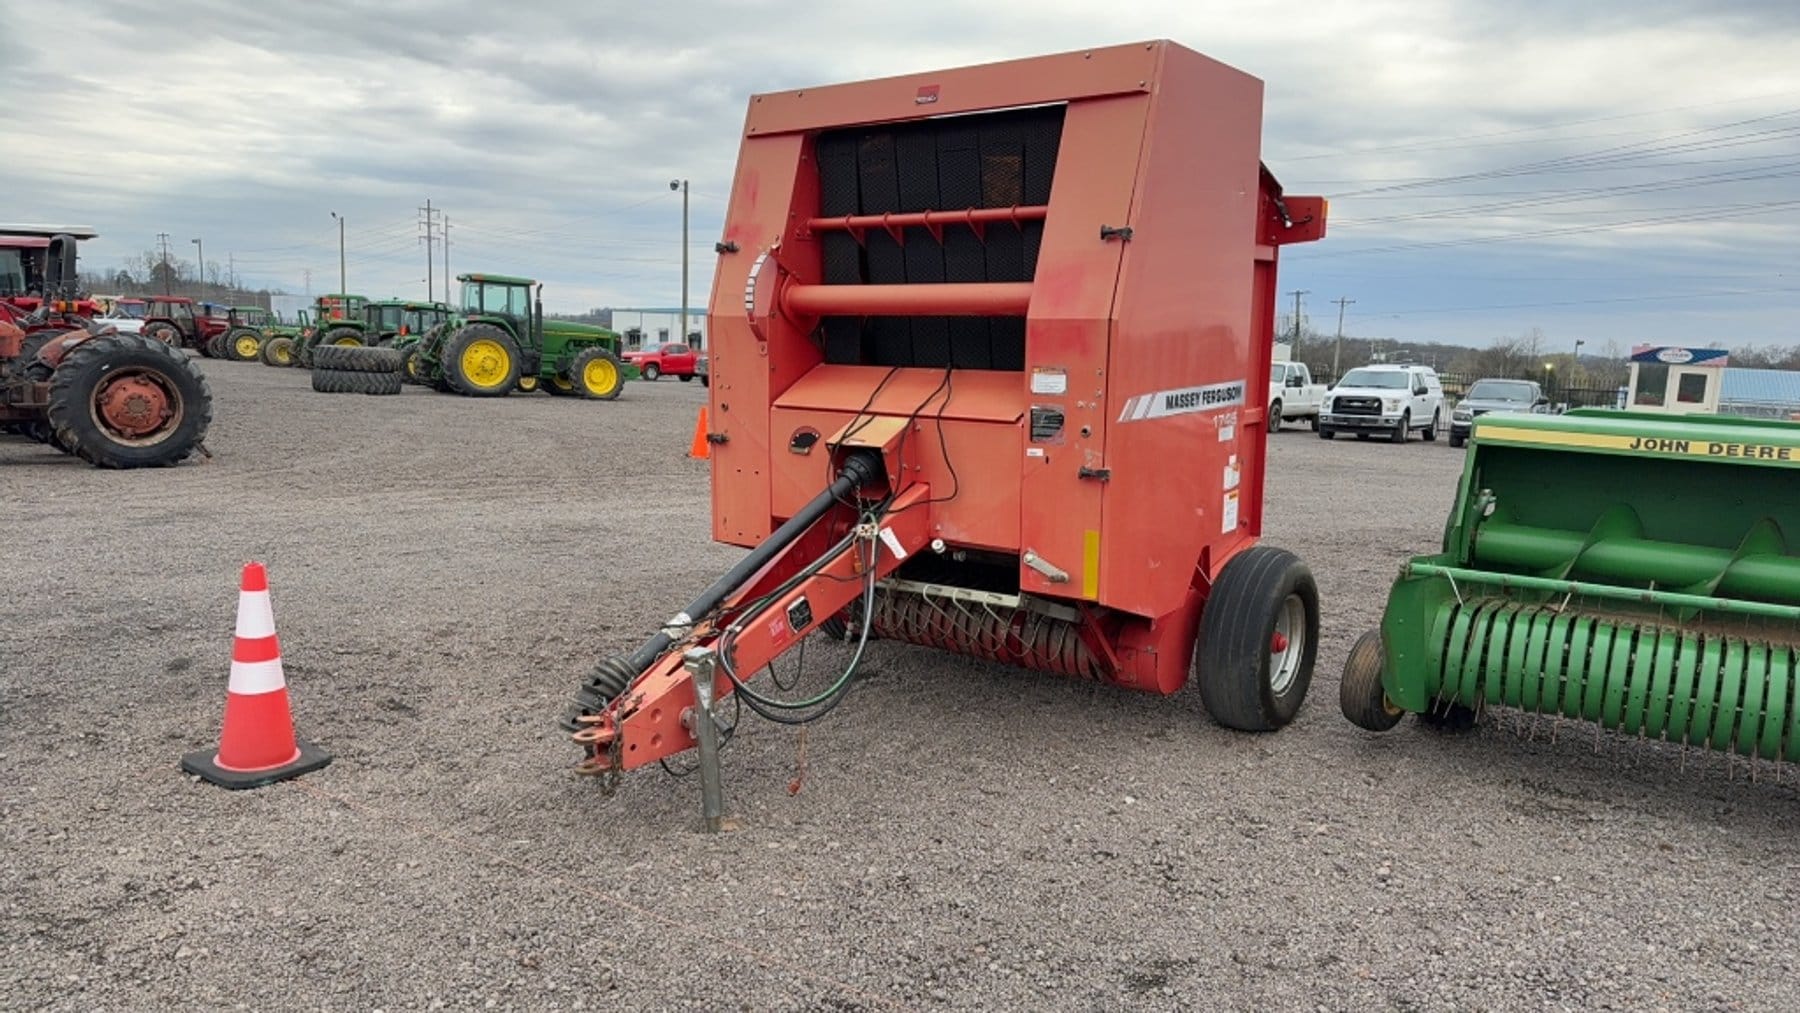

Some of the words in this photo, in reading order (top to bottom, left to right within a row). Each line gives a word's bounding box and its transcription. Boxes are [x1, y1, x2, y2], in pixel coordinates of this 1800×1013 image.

[1166, 392, 1200, 410] MASSEY
[1202, 385, 1242, 405] FERGUSON
[1629, 438, 1690, 453] JOHN
[1708, 443, 1792, 460] DEERE
